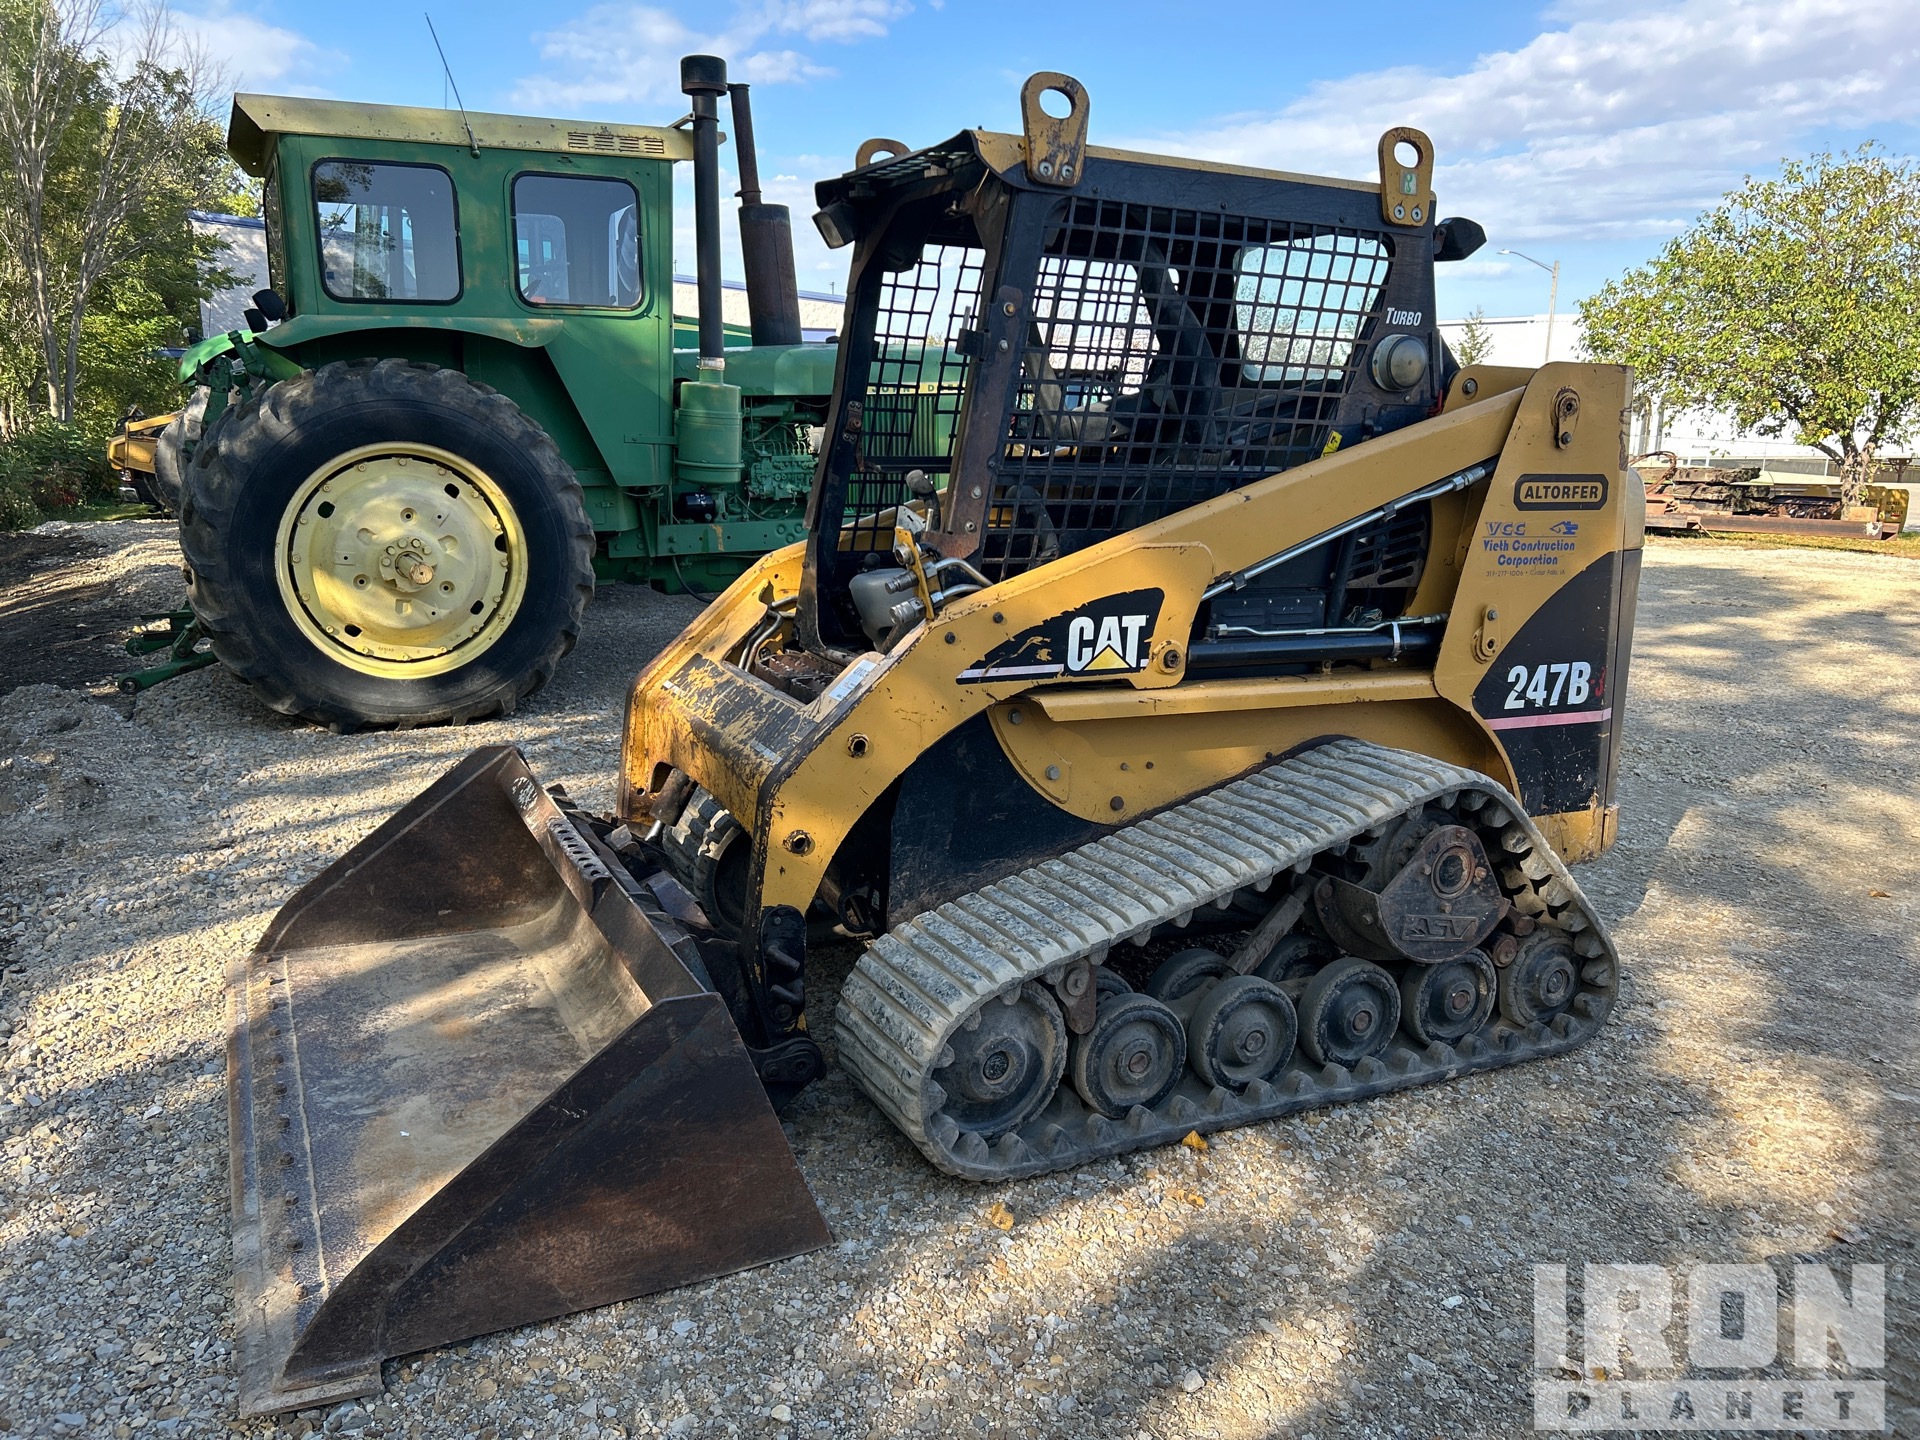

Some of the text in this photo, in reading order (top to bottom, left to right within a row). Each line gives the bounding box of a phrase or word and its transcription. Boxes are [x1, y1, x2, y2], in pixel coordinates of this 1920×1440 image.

[1386, 307, 1422, 327] TURBO
[1523, 485, 1599, 499] ALTORFER
[1485, 521, 1526, 536] VCC
[1483, 539, 1575, 552] Vieth Construction
[1497, 554, 1558, 569] Corporation
[1067, 614, 1147, 671] CAT
[1504, 661, 1592, 710] 247B
